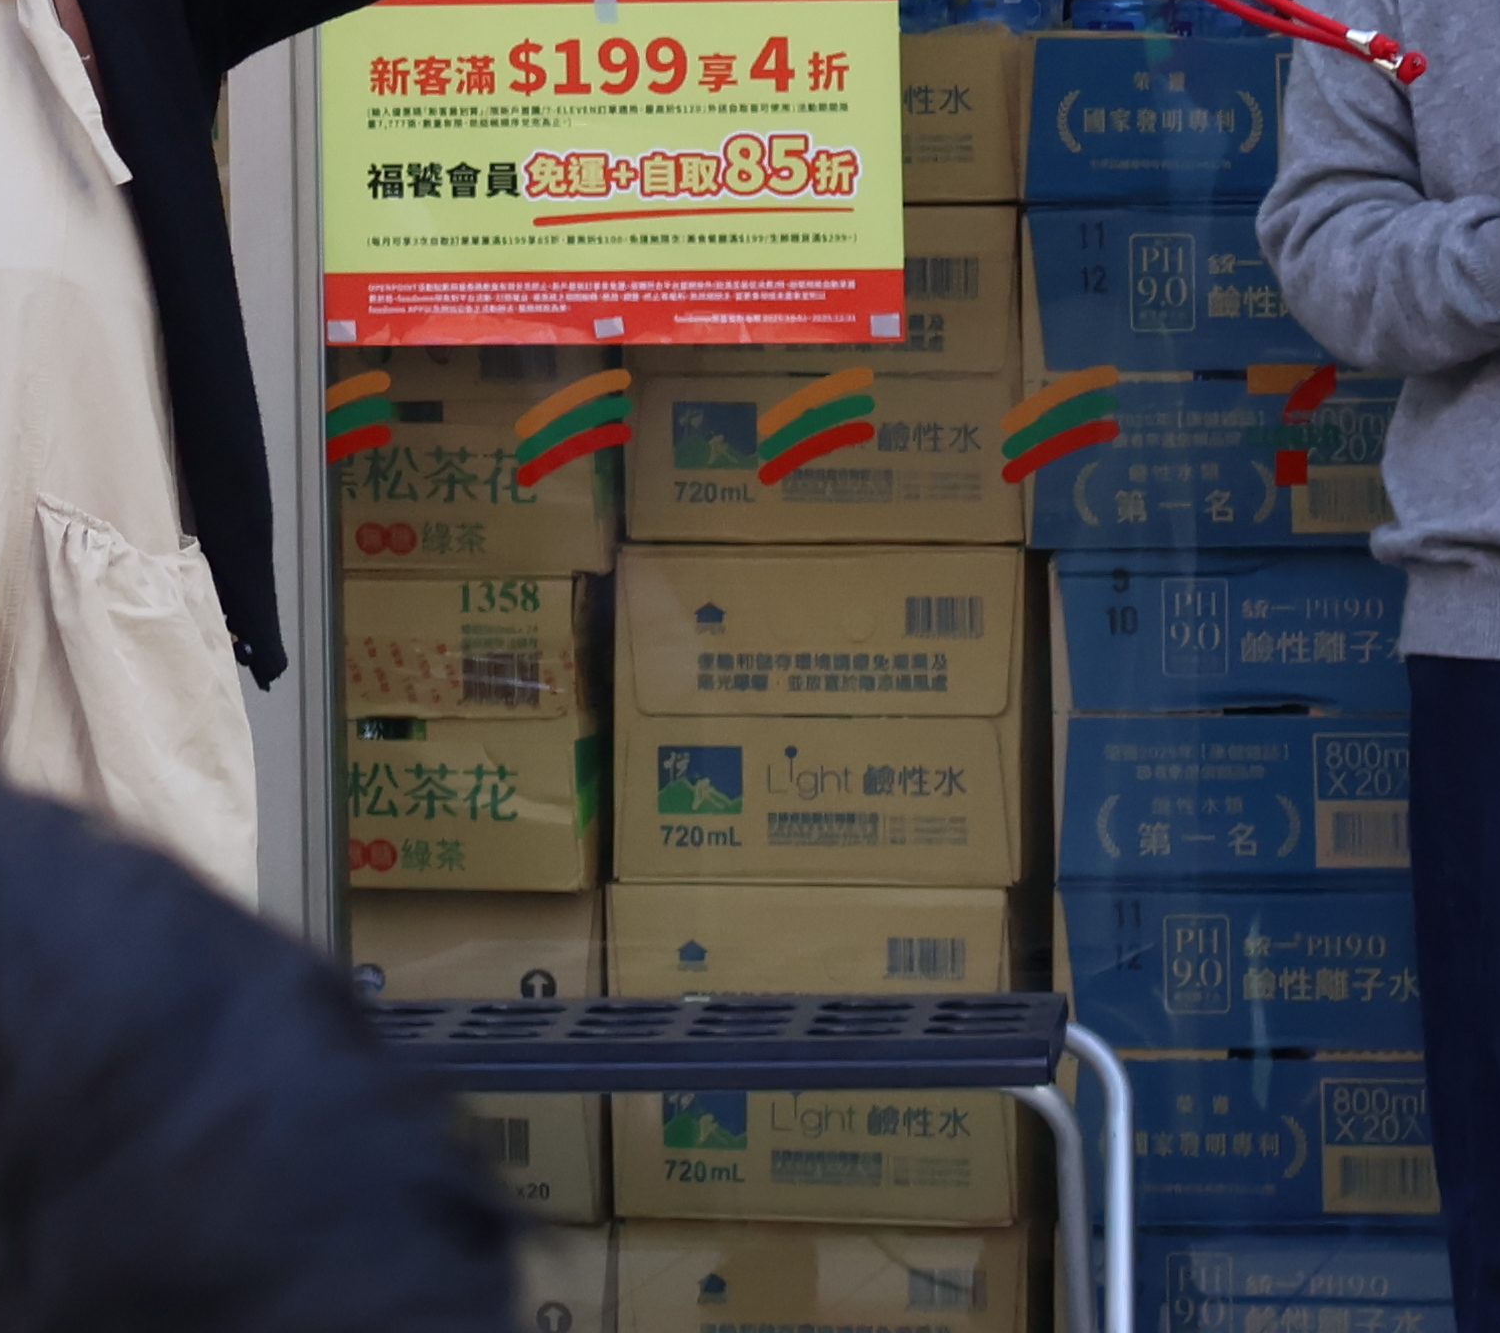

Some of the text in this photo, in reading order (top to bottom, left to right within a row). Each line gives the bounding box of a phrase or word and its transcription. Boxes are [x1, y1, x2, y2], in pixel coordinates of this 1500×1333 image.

[1082, 107, 1237, 135] 國家發明專利
[1141, 244, 1186, 274] PH
[1136, 277, 1189, 310] 9.0
[876, 421, 982, 454] 鹼性水
[673, 482, 757, 504] 720mL
[1115, 489, 1235, 524] 第一名
[459, 581, 541, 614] 1358
[1174, 590, 1218, 618] PH
[1170, 621, 1221, 651] 9.0
[862, 762, 968, 797] 鹼性水
[660, 824, 743, 848] 720mL
[1137, 821, 1259, 858] 第一名
[1176, 927, 1220, 954] PH
[1171, 959, 1223, 990] 9.0
[865, 1105, 972, 1140] 鹼性水
[663, 1158, 746, 1184] 720mL
